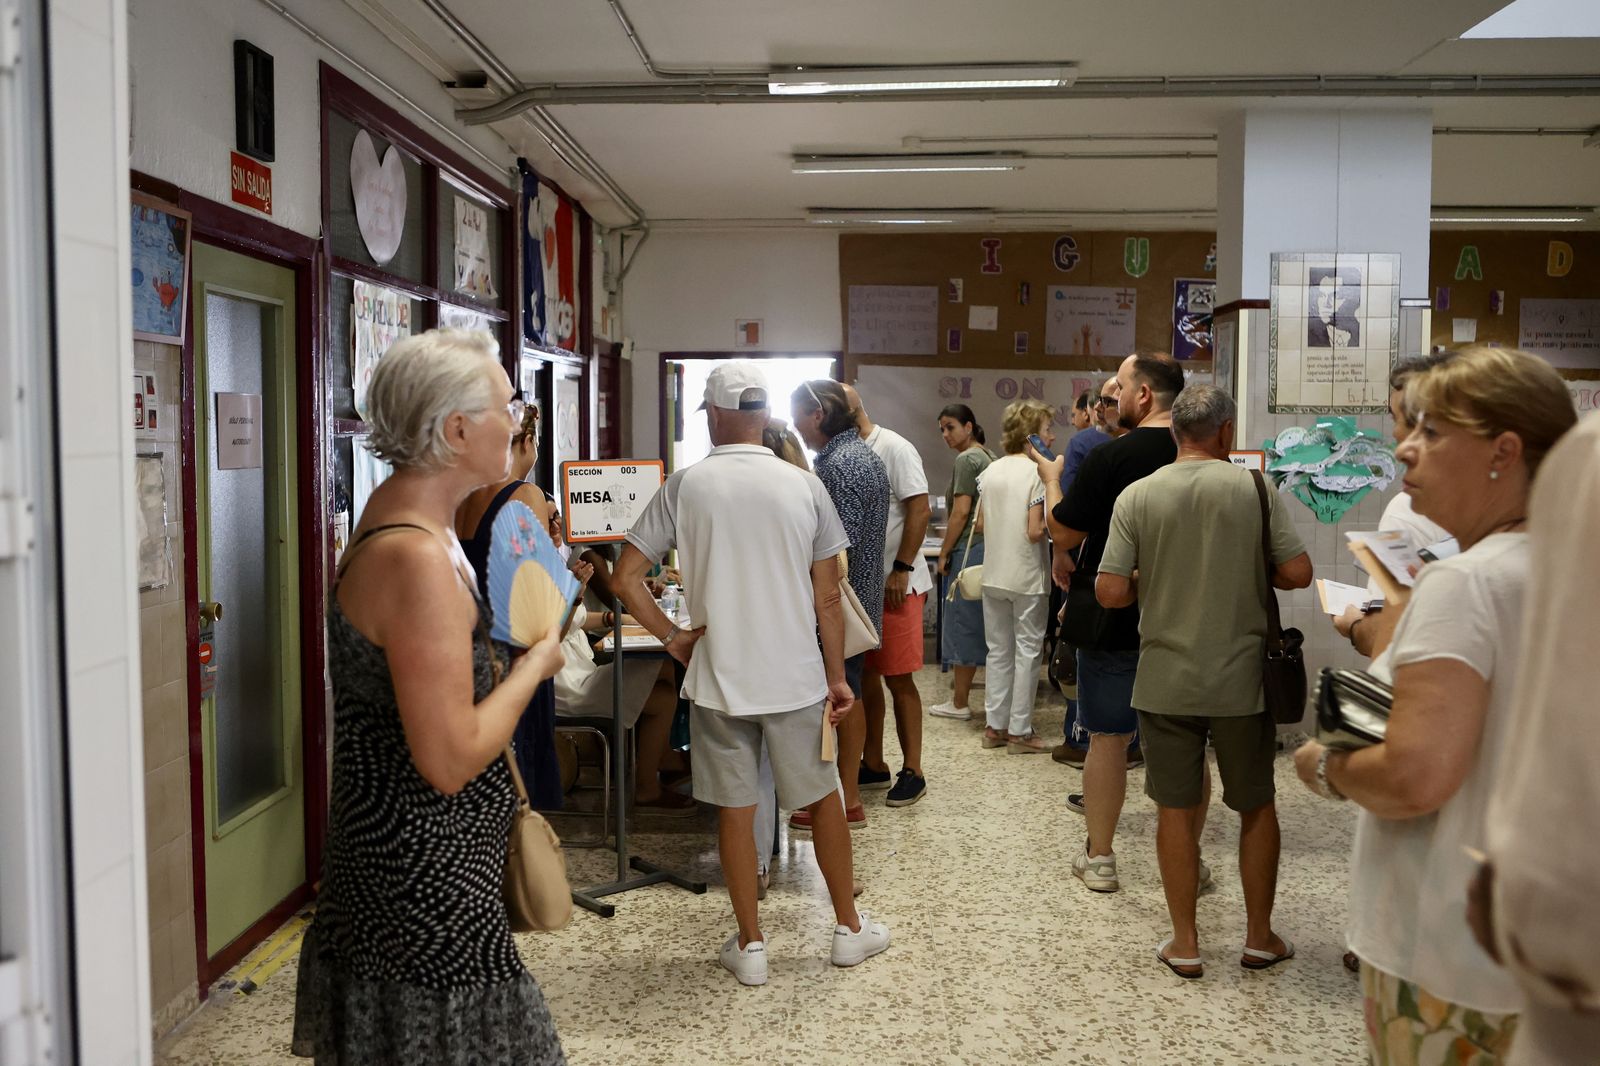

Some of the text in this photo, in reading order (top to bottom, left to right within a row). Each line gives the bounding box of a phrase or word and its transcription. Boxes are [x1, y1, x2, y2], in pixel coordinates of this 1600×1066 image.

[232, 164, 271, 202] SIN SALIDA
[938, 375, 972, 399] SI
[995, 377, 1046, 400] ON
[568, 466, 637, 476] SECCIÓN 003
[570, 490, 636, 504] MESA U
[605, 523, 613, 531] A
